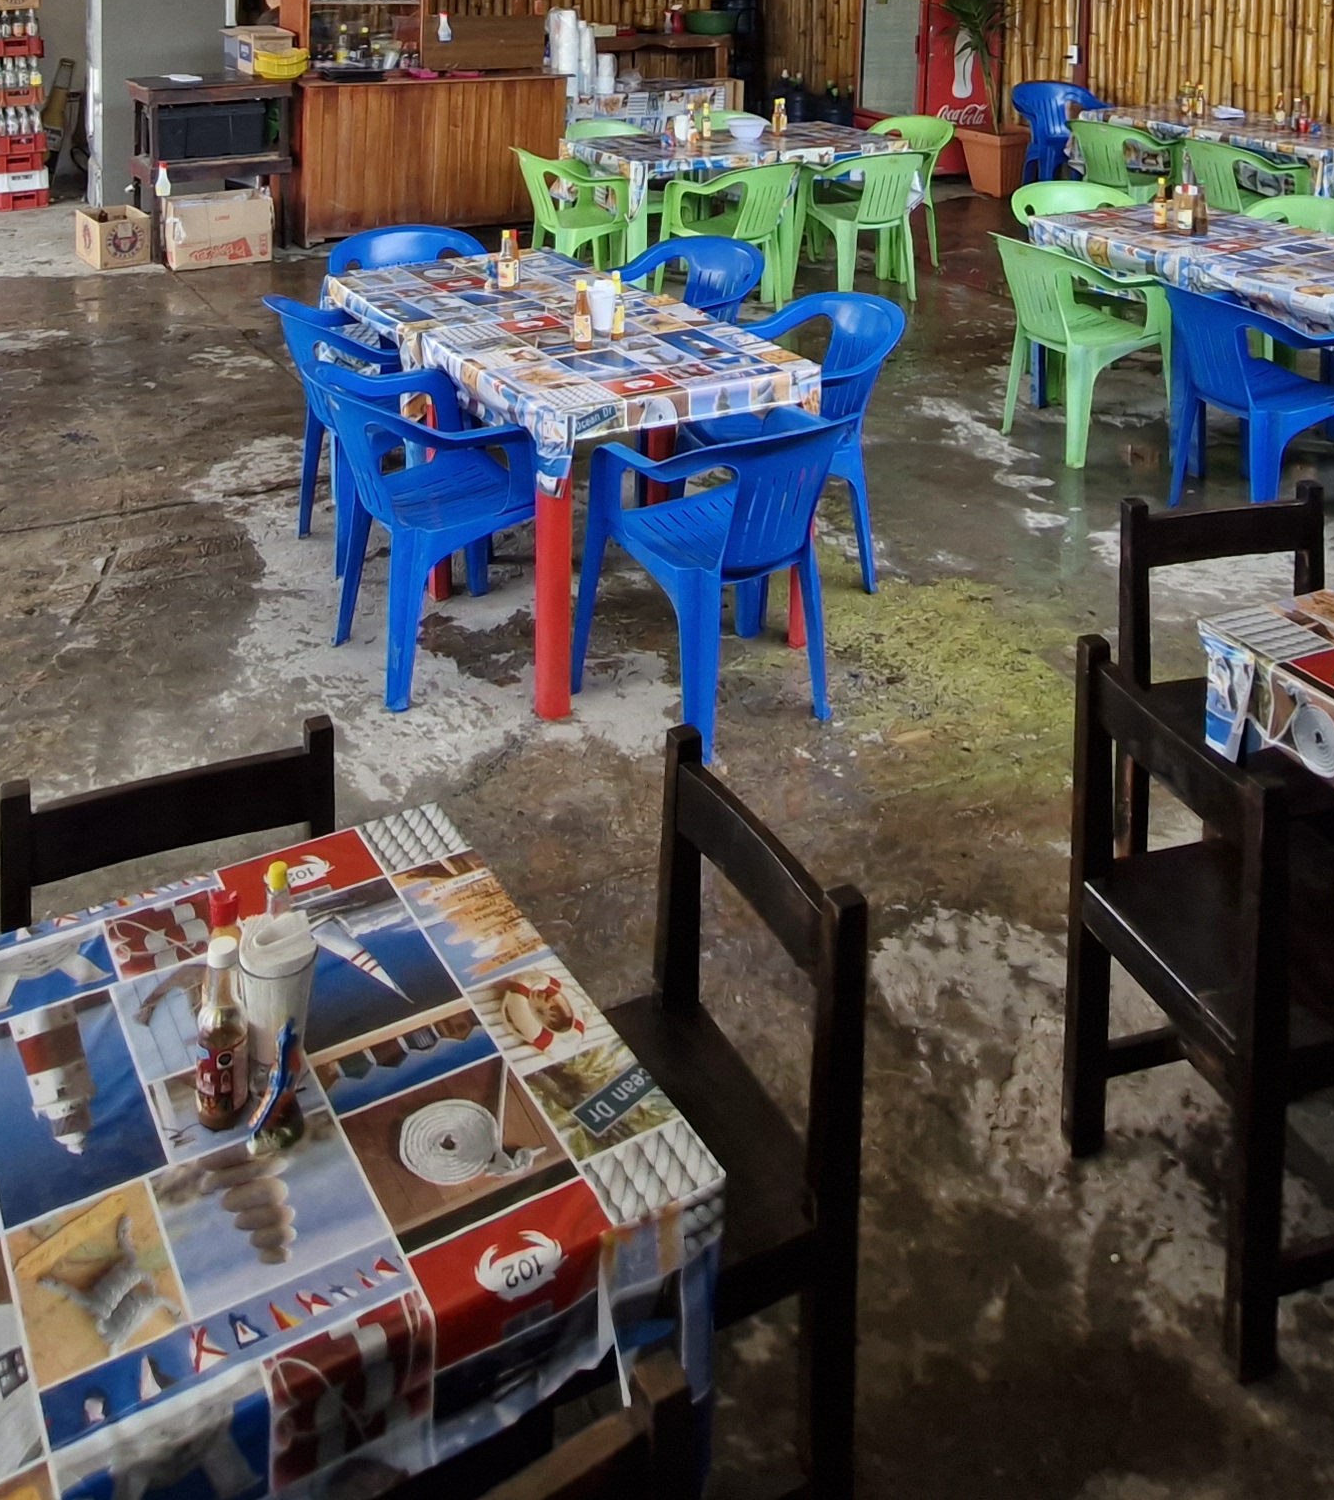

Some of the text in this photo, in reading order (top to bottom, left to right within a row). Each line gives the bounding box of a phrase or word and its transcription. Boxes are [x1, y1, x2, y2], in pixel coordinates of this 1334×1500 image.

[936, 103, 988, 126] Coca-Cola
[576, 406, 613, 432] Ocean Dr
[587, 1066, 652, 1123] cean Dr
[501, 1254, 544, 1288] 102
